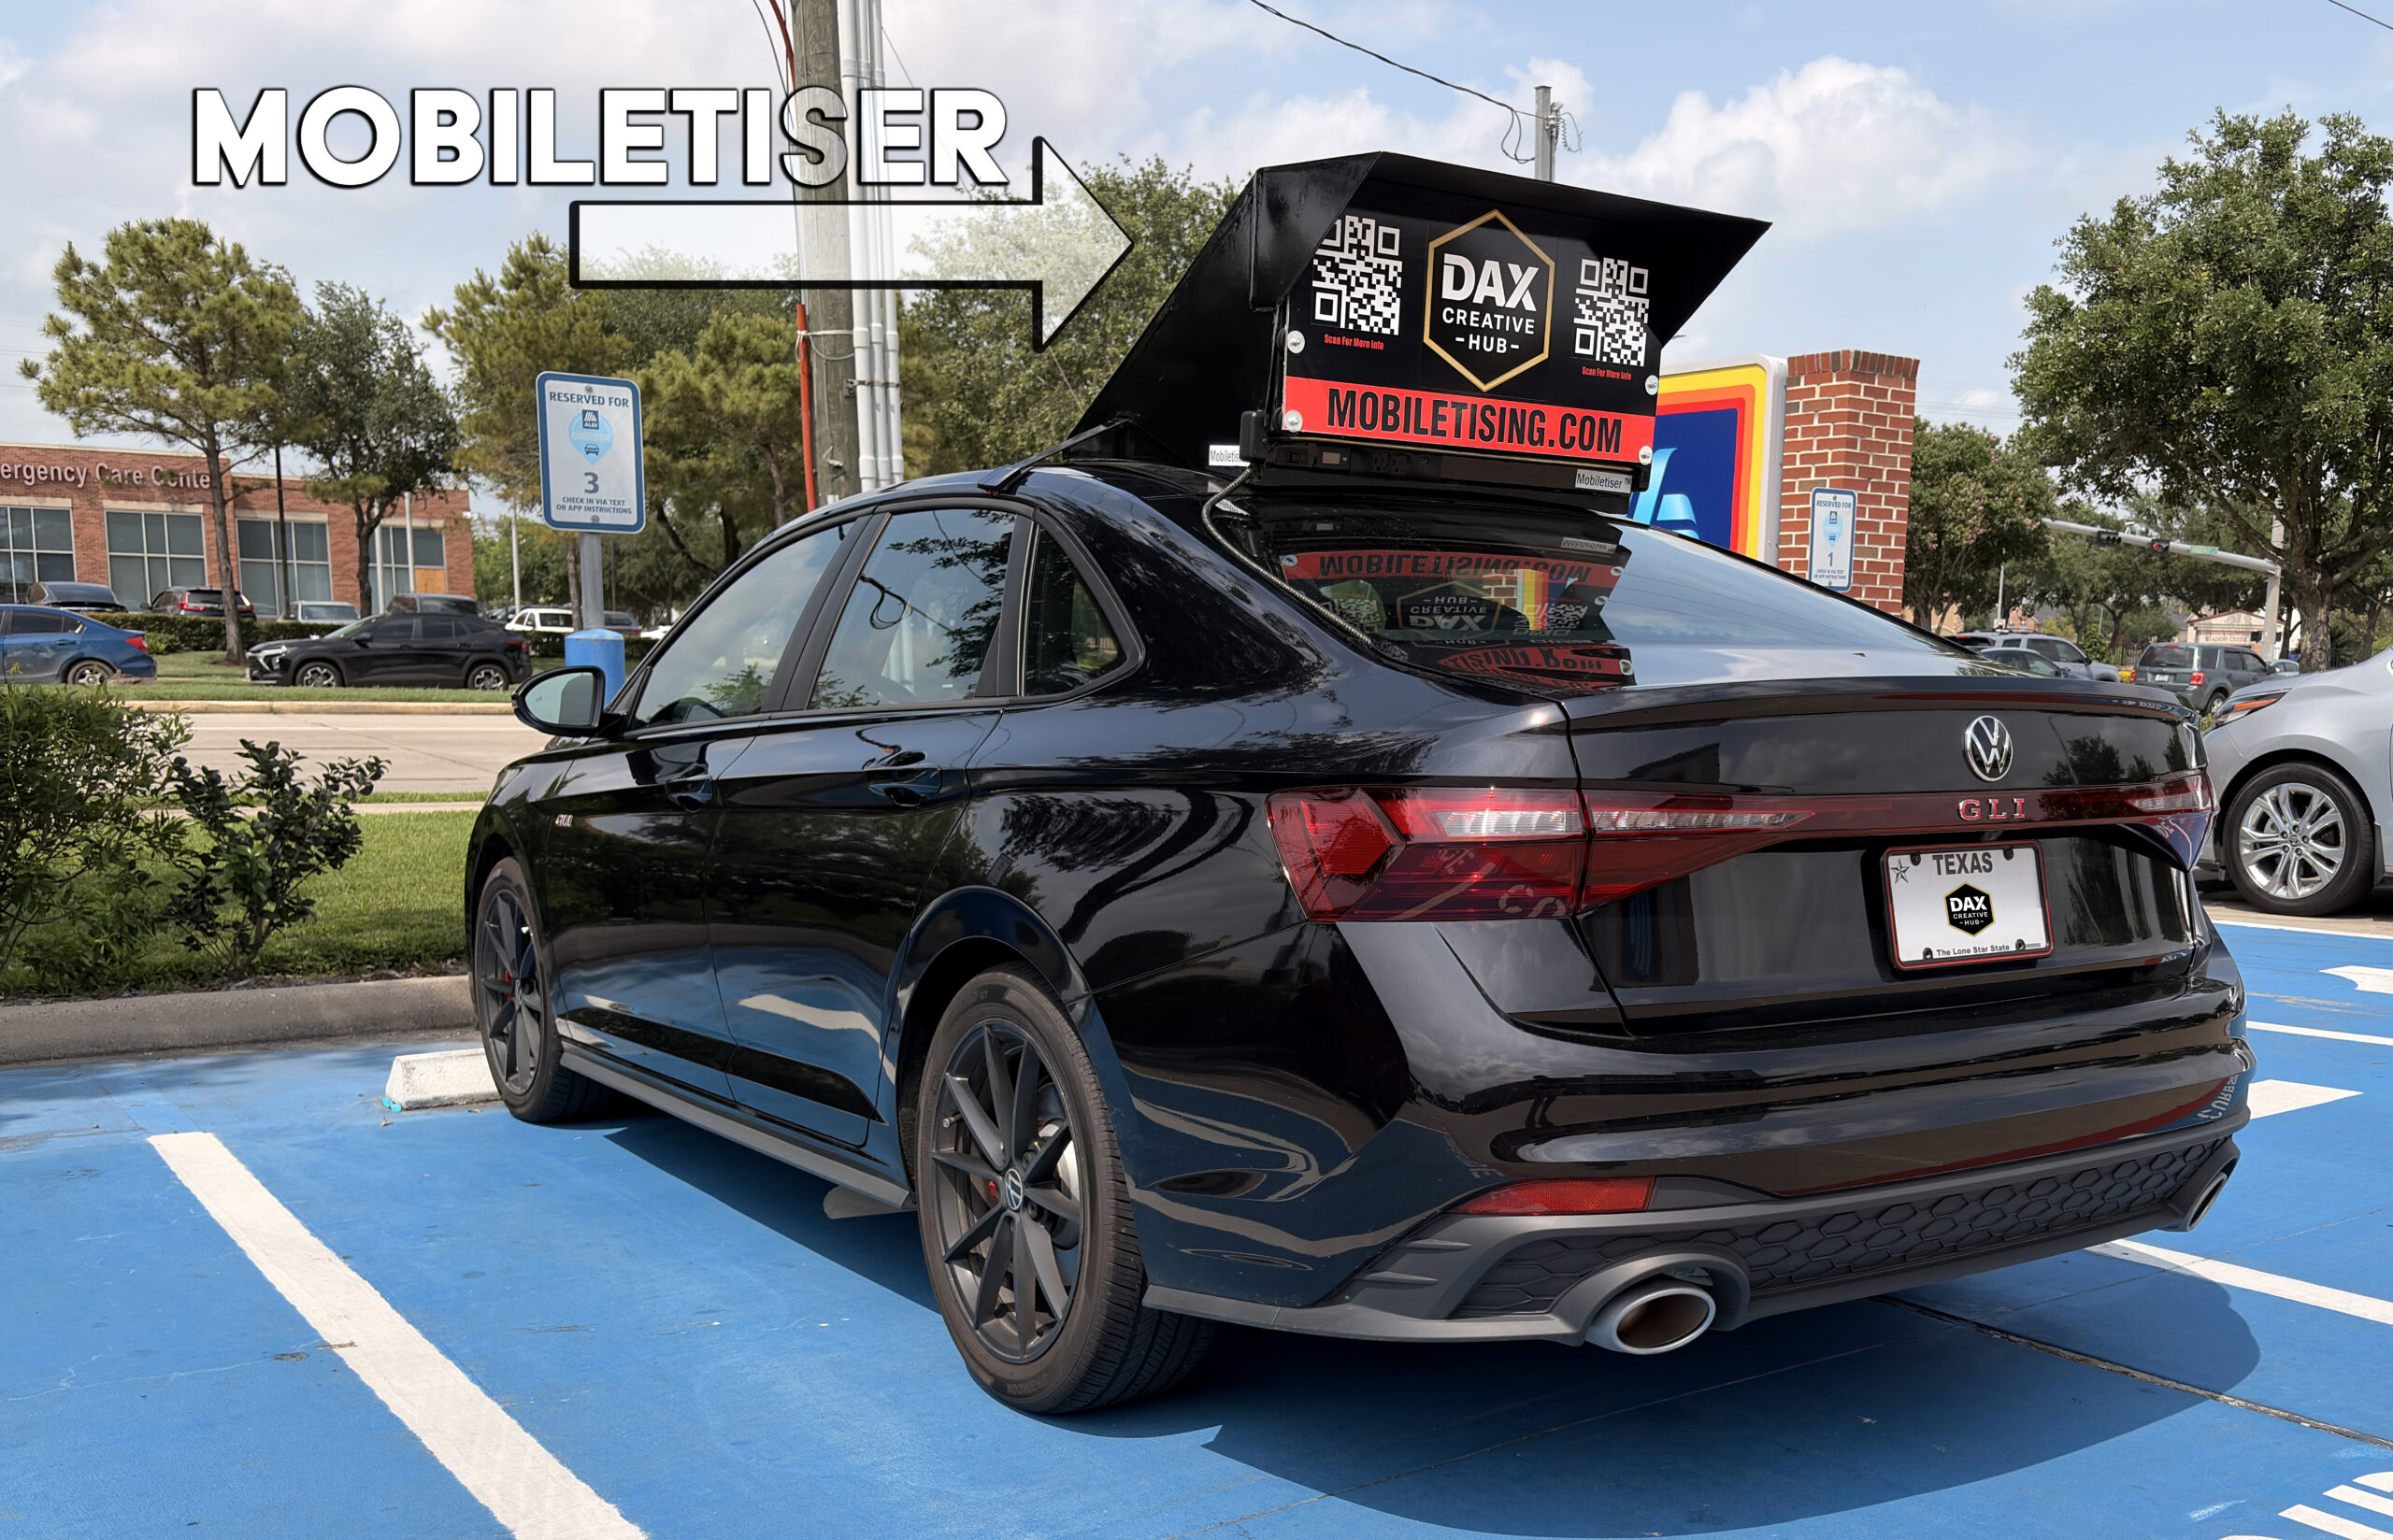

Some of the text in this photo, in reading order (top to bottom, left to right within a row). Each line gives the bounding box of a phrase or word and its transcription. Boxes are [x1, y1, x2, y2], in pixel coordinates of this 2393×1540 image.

[1441, 253, 1540, 312] DAX
[1441, 307, 1535, 335] CREATIVE
[1324, 334, 1384, 350] Scan For More Info
[1582, 366, 1632, 381] Scan For More Info
[549, 392, 629, 407] RESERVED FOR
[1327, 387, 1623, 454] MOBILETISING.COM
[1210, 449, 1241, 463] Mobiletis
[95, 463, 143, 484] Care
[1576, 473, 1623, 489] Mobiletiser
[583, 472, 599, 494] 3
[584, 506, 632, 514] INSTRUCTIONS
[1816, 500, 1841, 508] RESERVED
[1827, 552, 1833, 566] 1
[1958, 797, 2026, 821] GLI
[1932, 851, 1994, 876] TEXAS
[1949, 895, 1988, 912] DAX
[1953, 911, 1988, 920] CREATIVE
